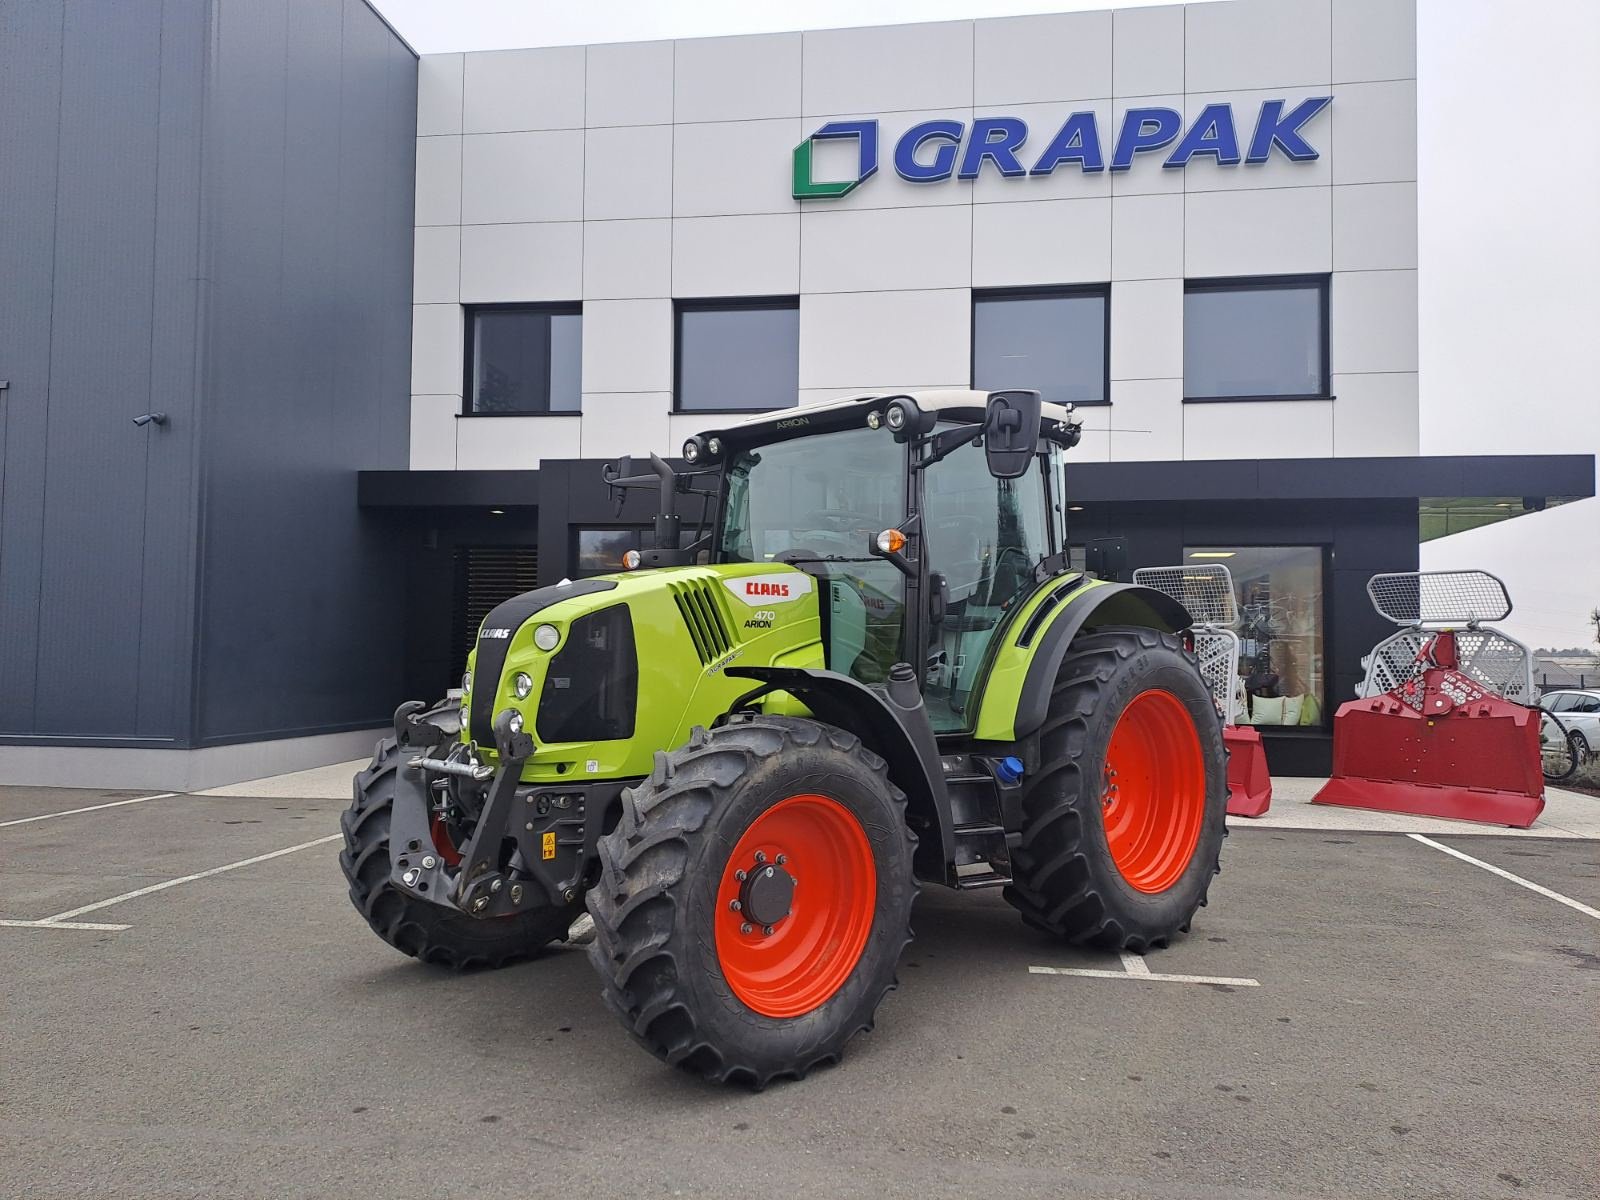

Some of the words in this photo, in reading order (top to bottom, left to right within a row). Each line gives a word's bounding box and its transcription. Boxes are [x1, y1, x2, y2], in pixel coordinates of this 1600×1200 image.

[893, 96, 1334, 183] GRAPAK
[776, 416, 810, 430] ARION
[746, 582, 789, 596] CLAAS
[754, 610, 776, 620] 470
[743, 620, 772, 629] ARION
[480, 628, 511, 639] CLAAS
[1443, 672, 1457, 683] VIP
[1455, 681, 1472, 693] PRO
